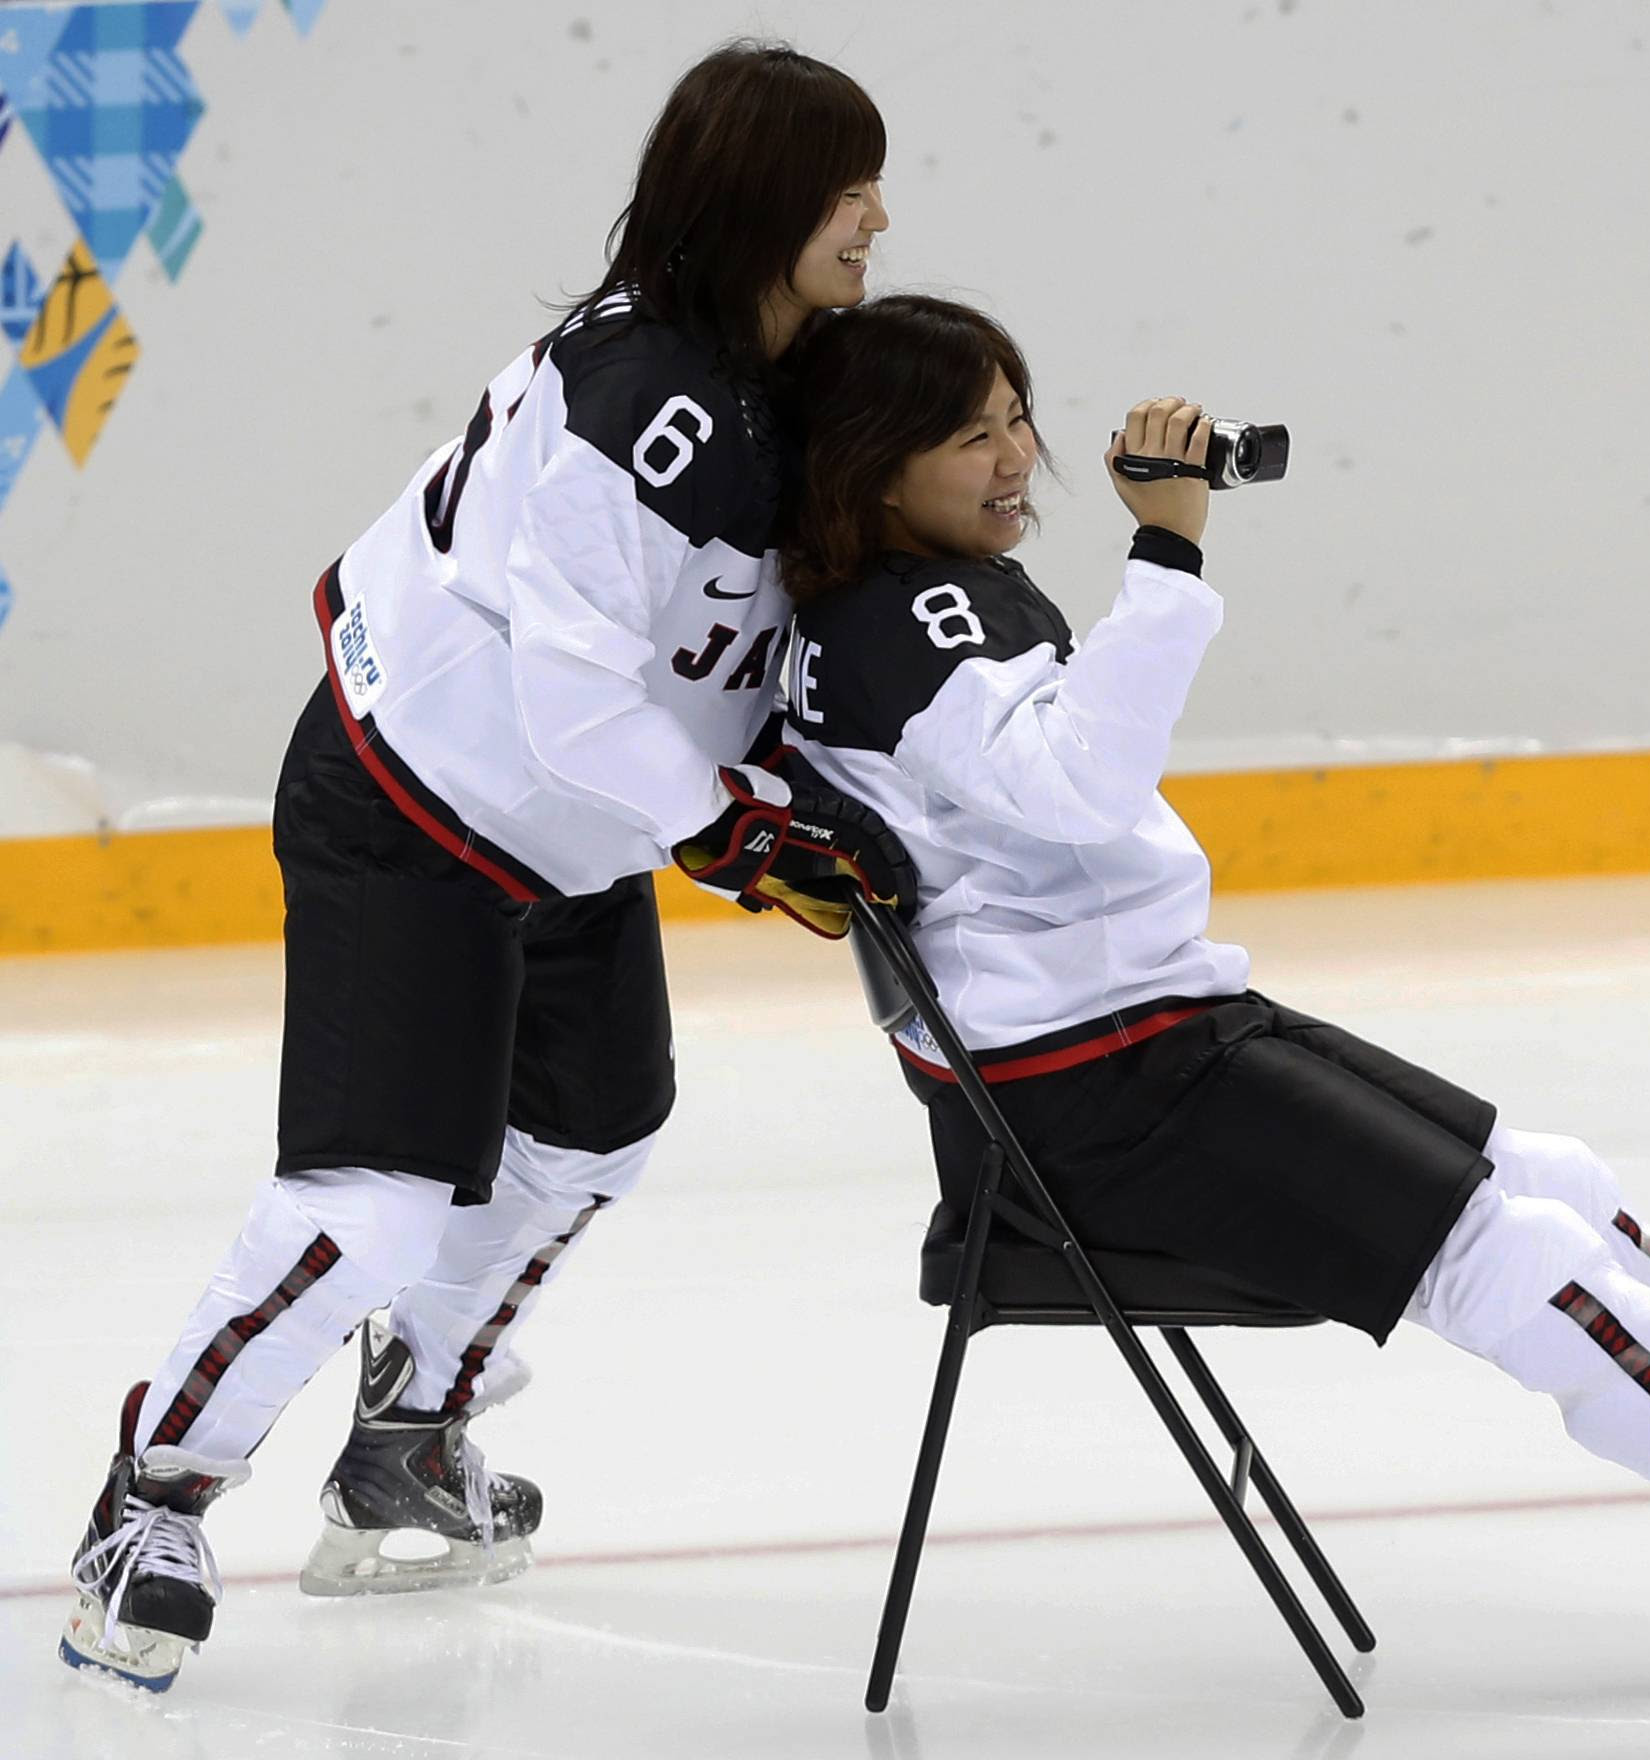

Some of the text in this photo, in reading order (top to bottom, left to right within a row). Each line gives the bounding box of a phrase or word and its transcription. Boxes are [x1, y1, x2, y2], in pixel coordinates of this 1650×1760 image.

[633, 395, 713, 488] 6
[911, 583, 986, 649] 8
[340, 623, 358, 676] 2014
